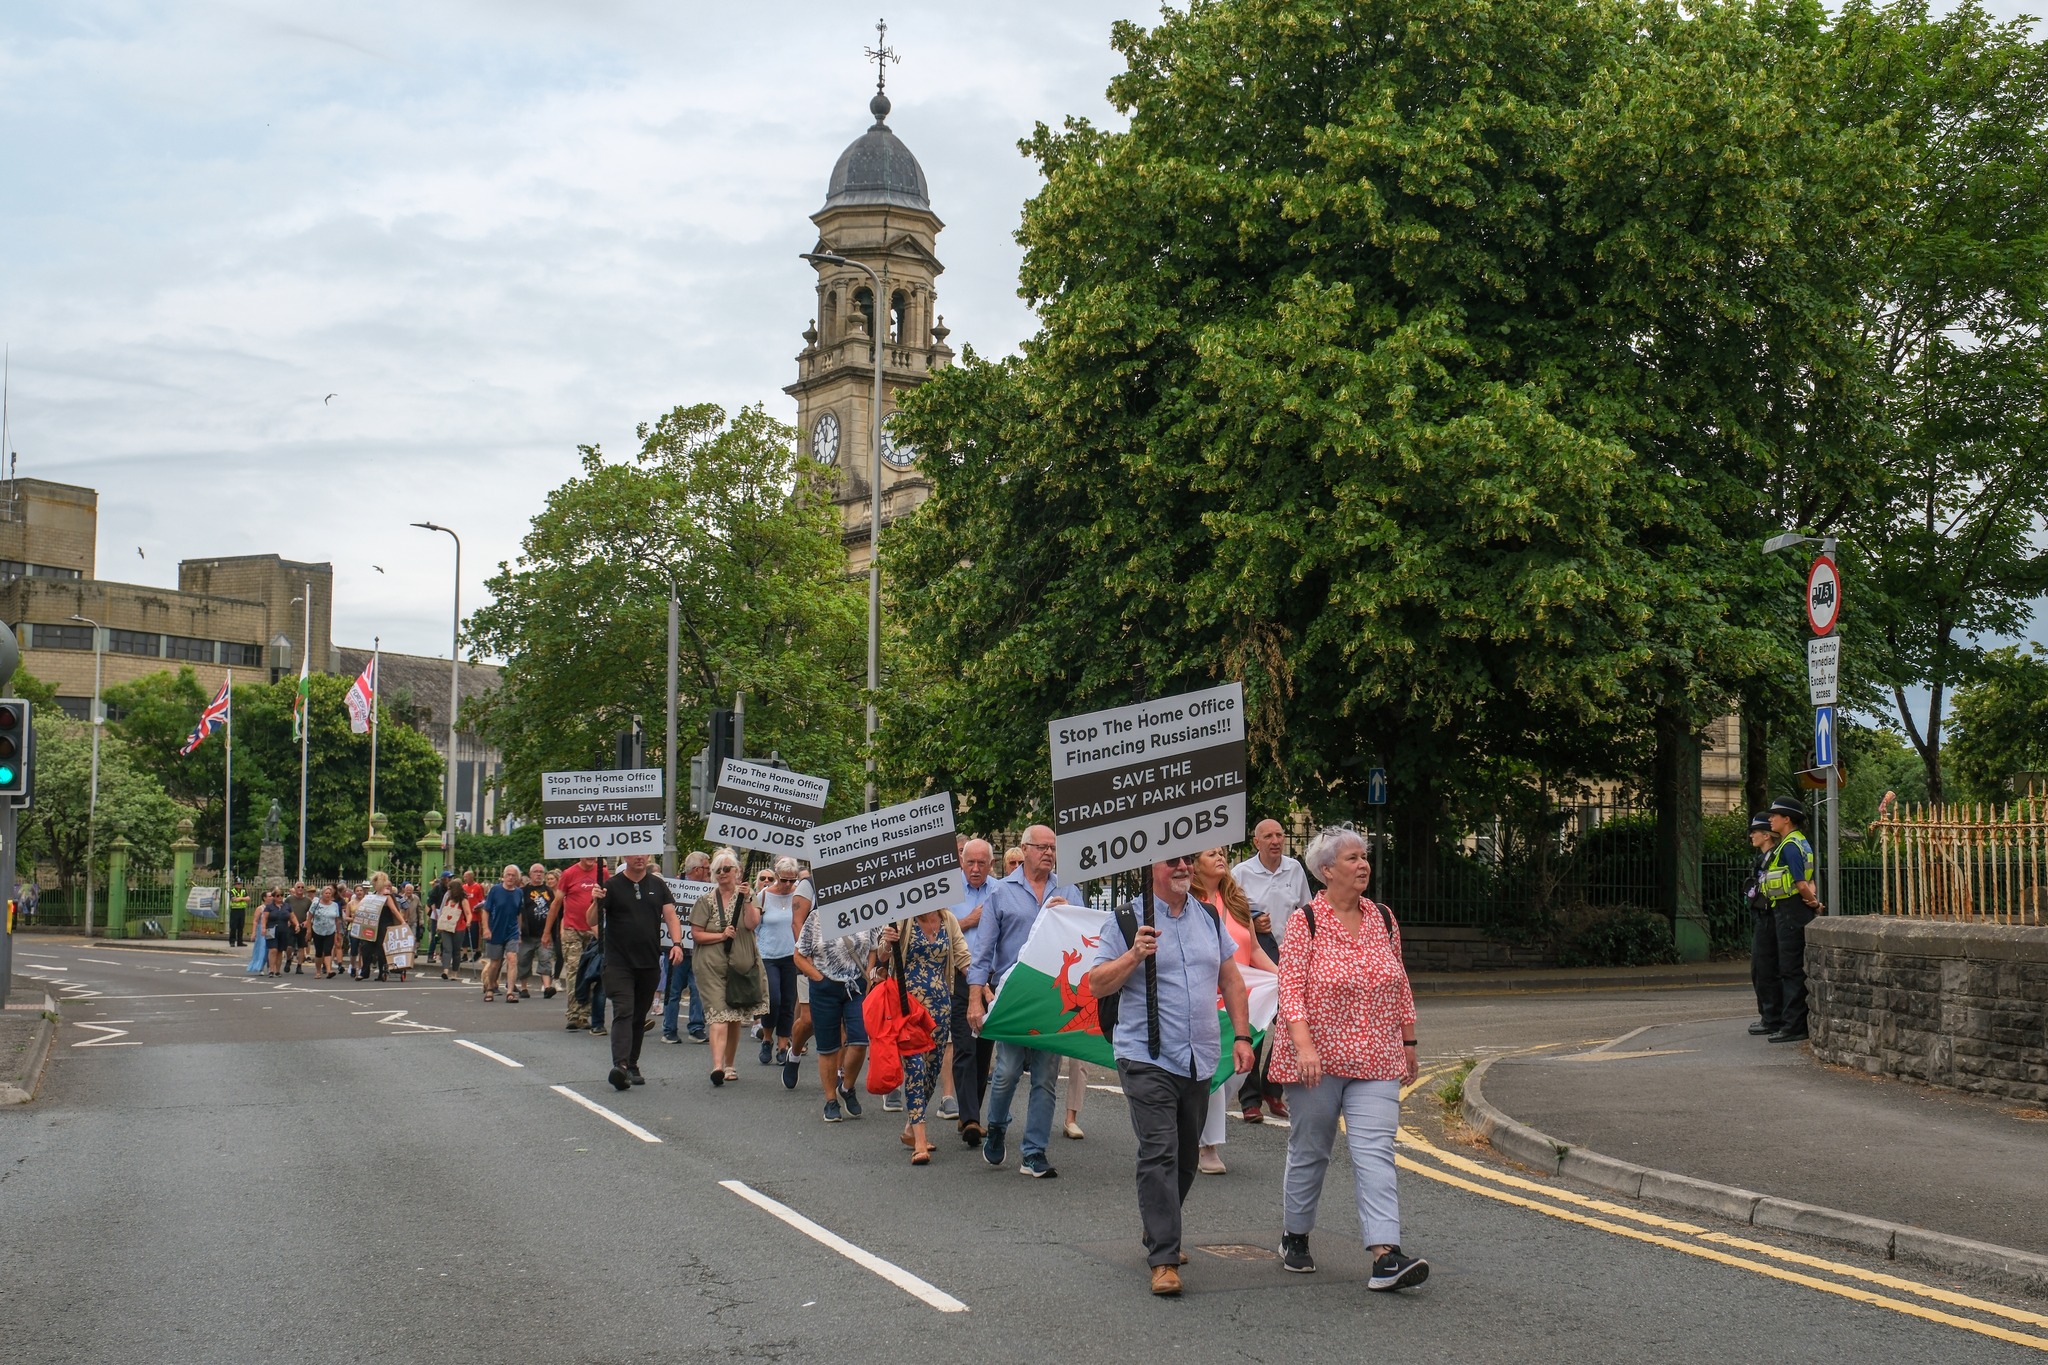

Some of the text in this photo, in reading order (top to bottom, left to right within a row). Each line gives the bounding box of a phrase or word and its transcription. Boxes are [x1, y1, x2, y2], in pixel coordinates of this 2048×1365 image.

[1811, 642, 1836, 654] Ac eithrio
[1811, 655, 1835, 669] mynediad
[1811, 674, 1827, 687] Except
[1816, 690, 1831, 698] access
[1059, 698, 1234, 744] Stop The Home Office
[1066, 718, 1231, 766] Financing Russians!!!
[548, 773, 656, 784] Stop The Home Office
[727, 763, 823, 791] Stop The Home Office
[1112, 760, 1192, 790] SAVE THE
[551, 784, 654, 795] Financing Russians!!!
[727, 775, 819, 802] Financing Russians!!!
[1058, 771, 1243, 825] STRADEY PARK HOTEL
[578, 804, 605, 812] SAVE
[714, 801, 758, 816] STRADEY
[760, 810, 784, 822] PARK
[747, 797, 792, 813] SAVE THE
[545, 813, 661, 824] STRADEY PARK HOTEL
[813, 803, 945, 844] Stop The Home Office
[558, 830, 652, 850] &100 JOBS
[719, 824, 805, 847] &100 JOBS
[819, 817, 944, 858] Financing Russians!!!
[1079, 805, 1228, 870] &100 JOBS
[856, 848, 916, 873] SAVE THE
[679, 882, 700, 891] Home
[818, 853, 957, 899] STRADEY PARK HOTEL
[837, 878, 950, 929] &100 JOBS
